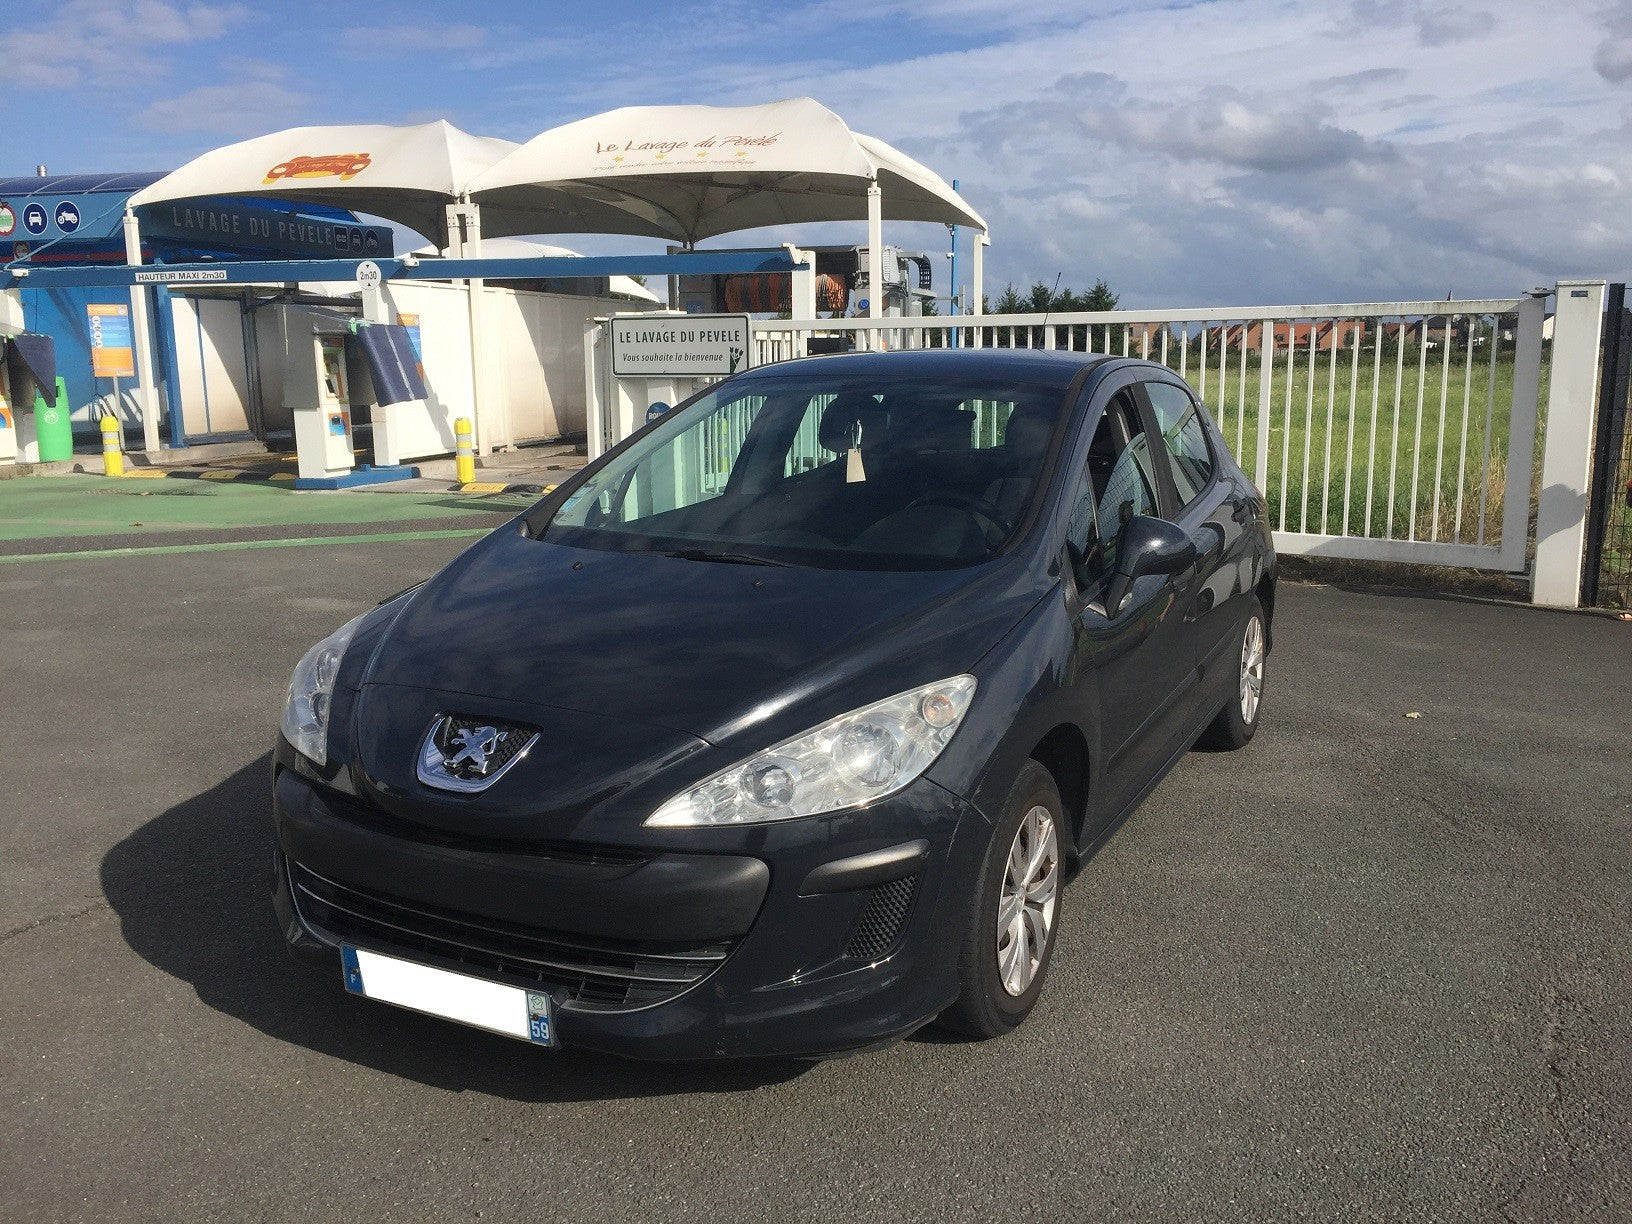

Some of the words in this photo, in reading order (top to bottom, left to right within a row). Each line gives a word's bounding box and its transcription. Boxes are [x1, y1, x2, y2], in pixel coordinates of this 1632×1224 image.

[596, 141, 619, 154] Le
[624, 140, 689, 153] Lavage
[694, 135, 717, 148] du
[172, 206, 241, 234] LAVAGE
[250, 217, 270, 238] DU
[279, 221, 332, 246] PEVELE
[138, 272, 176, 281] HAUTEUR
[178, 272, 200, 280] MAXI
[202, 271, 225, 279] 2m30
[360, 270, 377, 280] 2m30
[619, 331, 631, 343] LE
[635, 331, 676, 343] LAVAGE
[680, 331, 695, 343] DU
[700, 330, 740, 342] PEVELE
[622, 353, 640, 362] Vous
[641, 352, 674, 362] souhaite
[675, 352, 683, 361] la
[684, 352, 723, 362] bienvenue
[351, 974, 356, 983] F
[530, 1021, 549, 1040] 59
